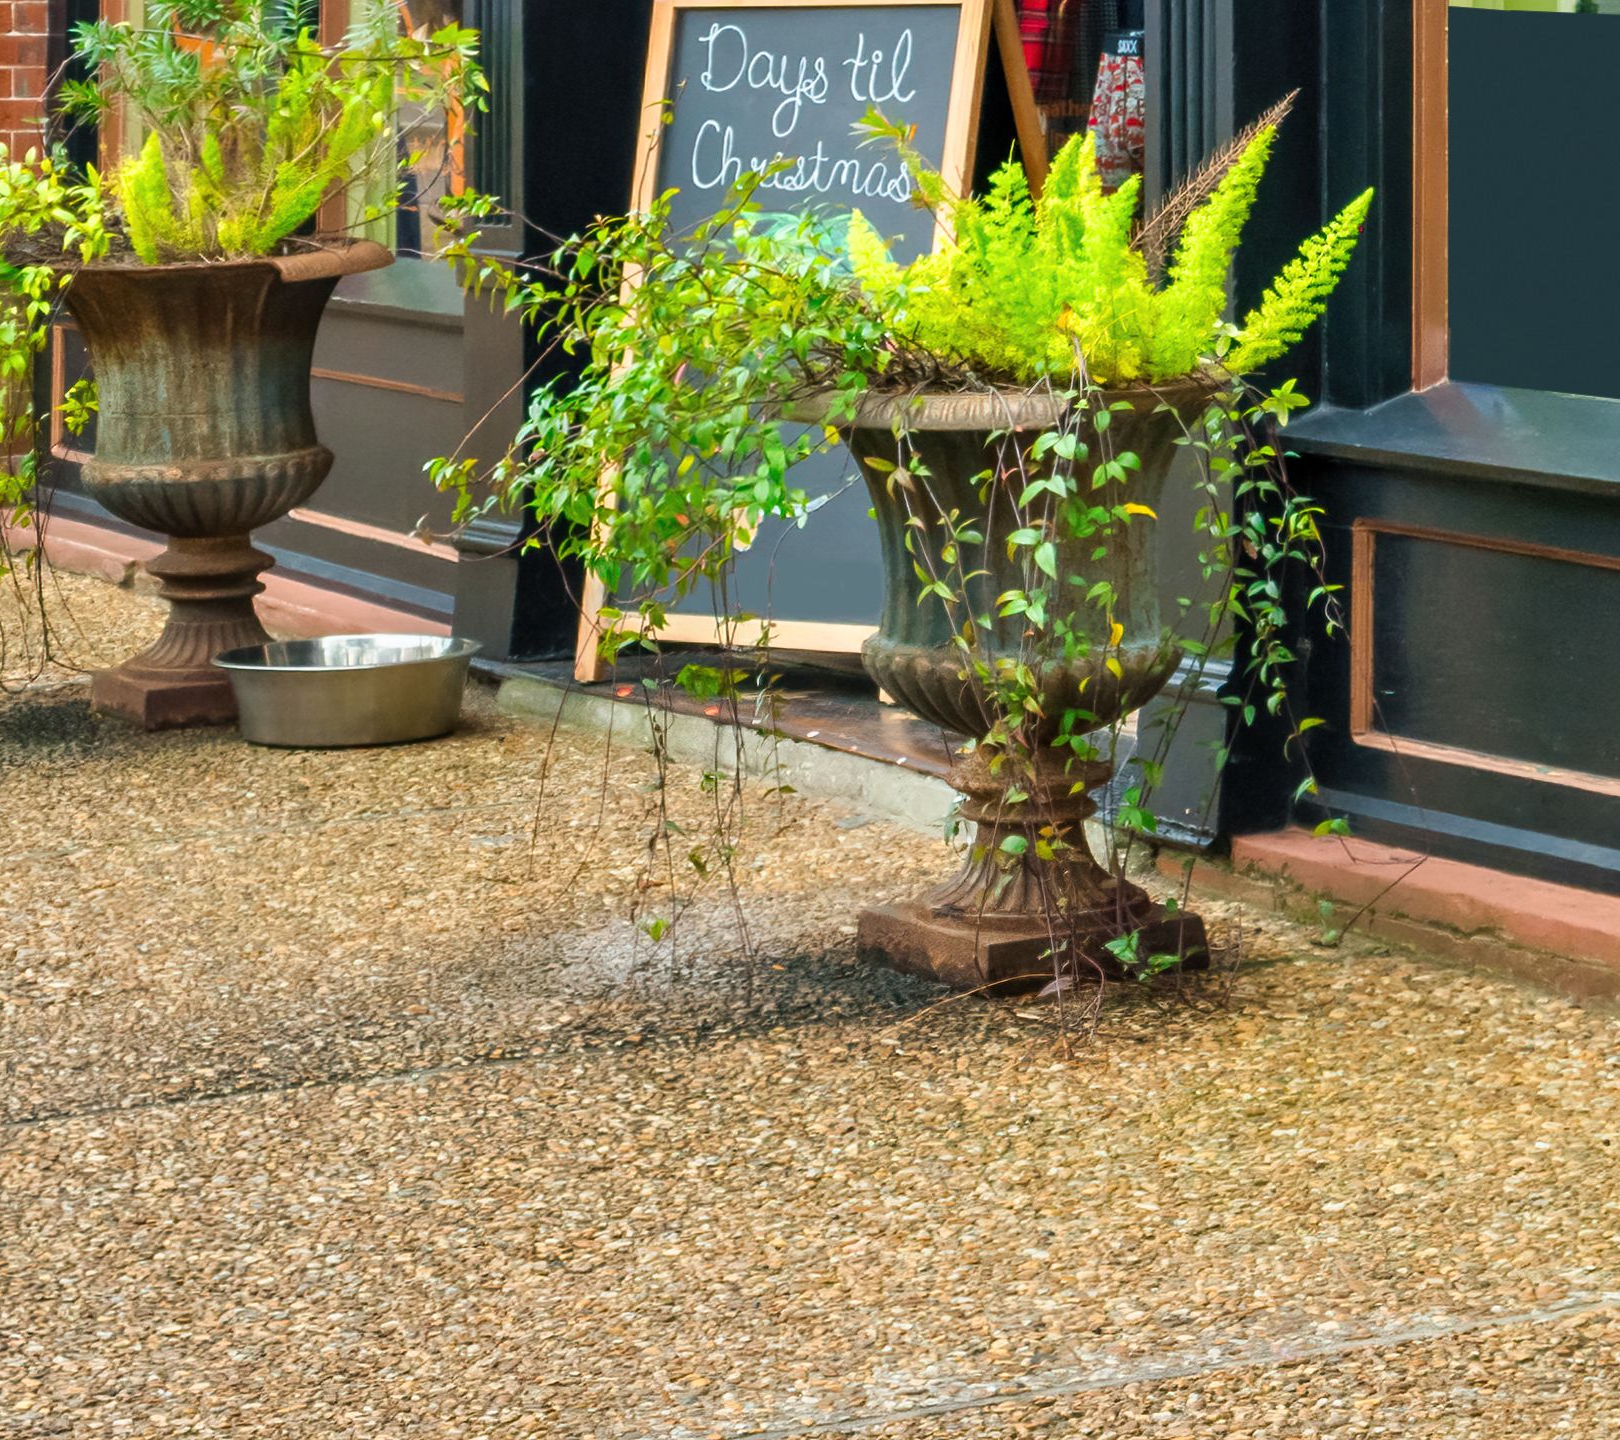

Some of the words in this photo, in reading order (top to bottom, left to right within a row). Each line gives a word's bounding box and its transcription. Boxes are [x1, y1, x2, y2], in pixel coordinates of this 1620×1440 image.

[698, 23, 828, 138] Days
[842, 29, 917, 102] til
[692, 119, 912, 203] Christmas
